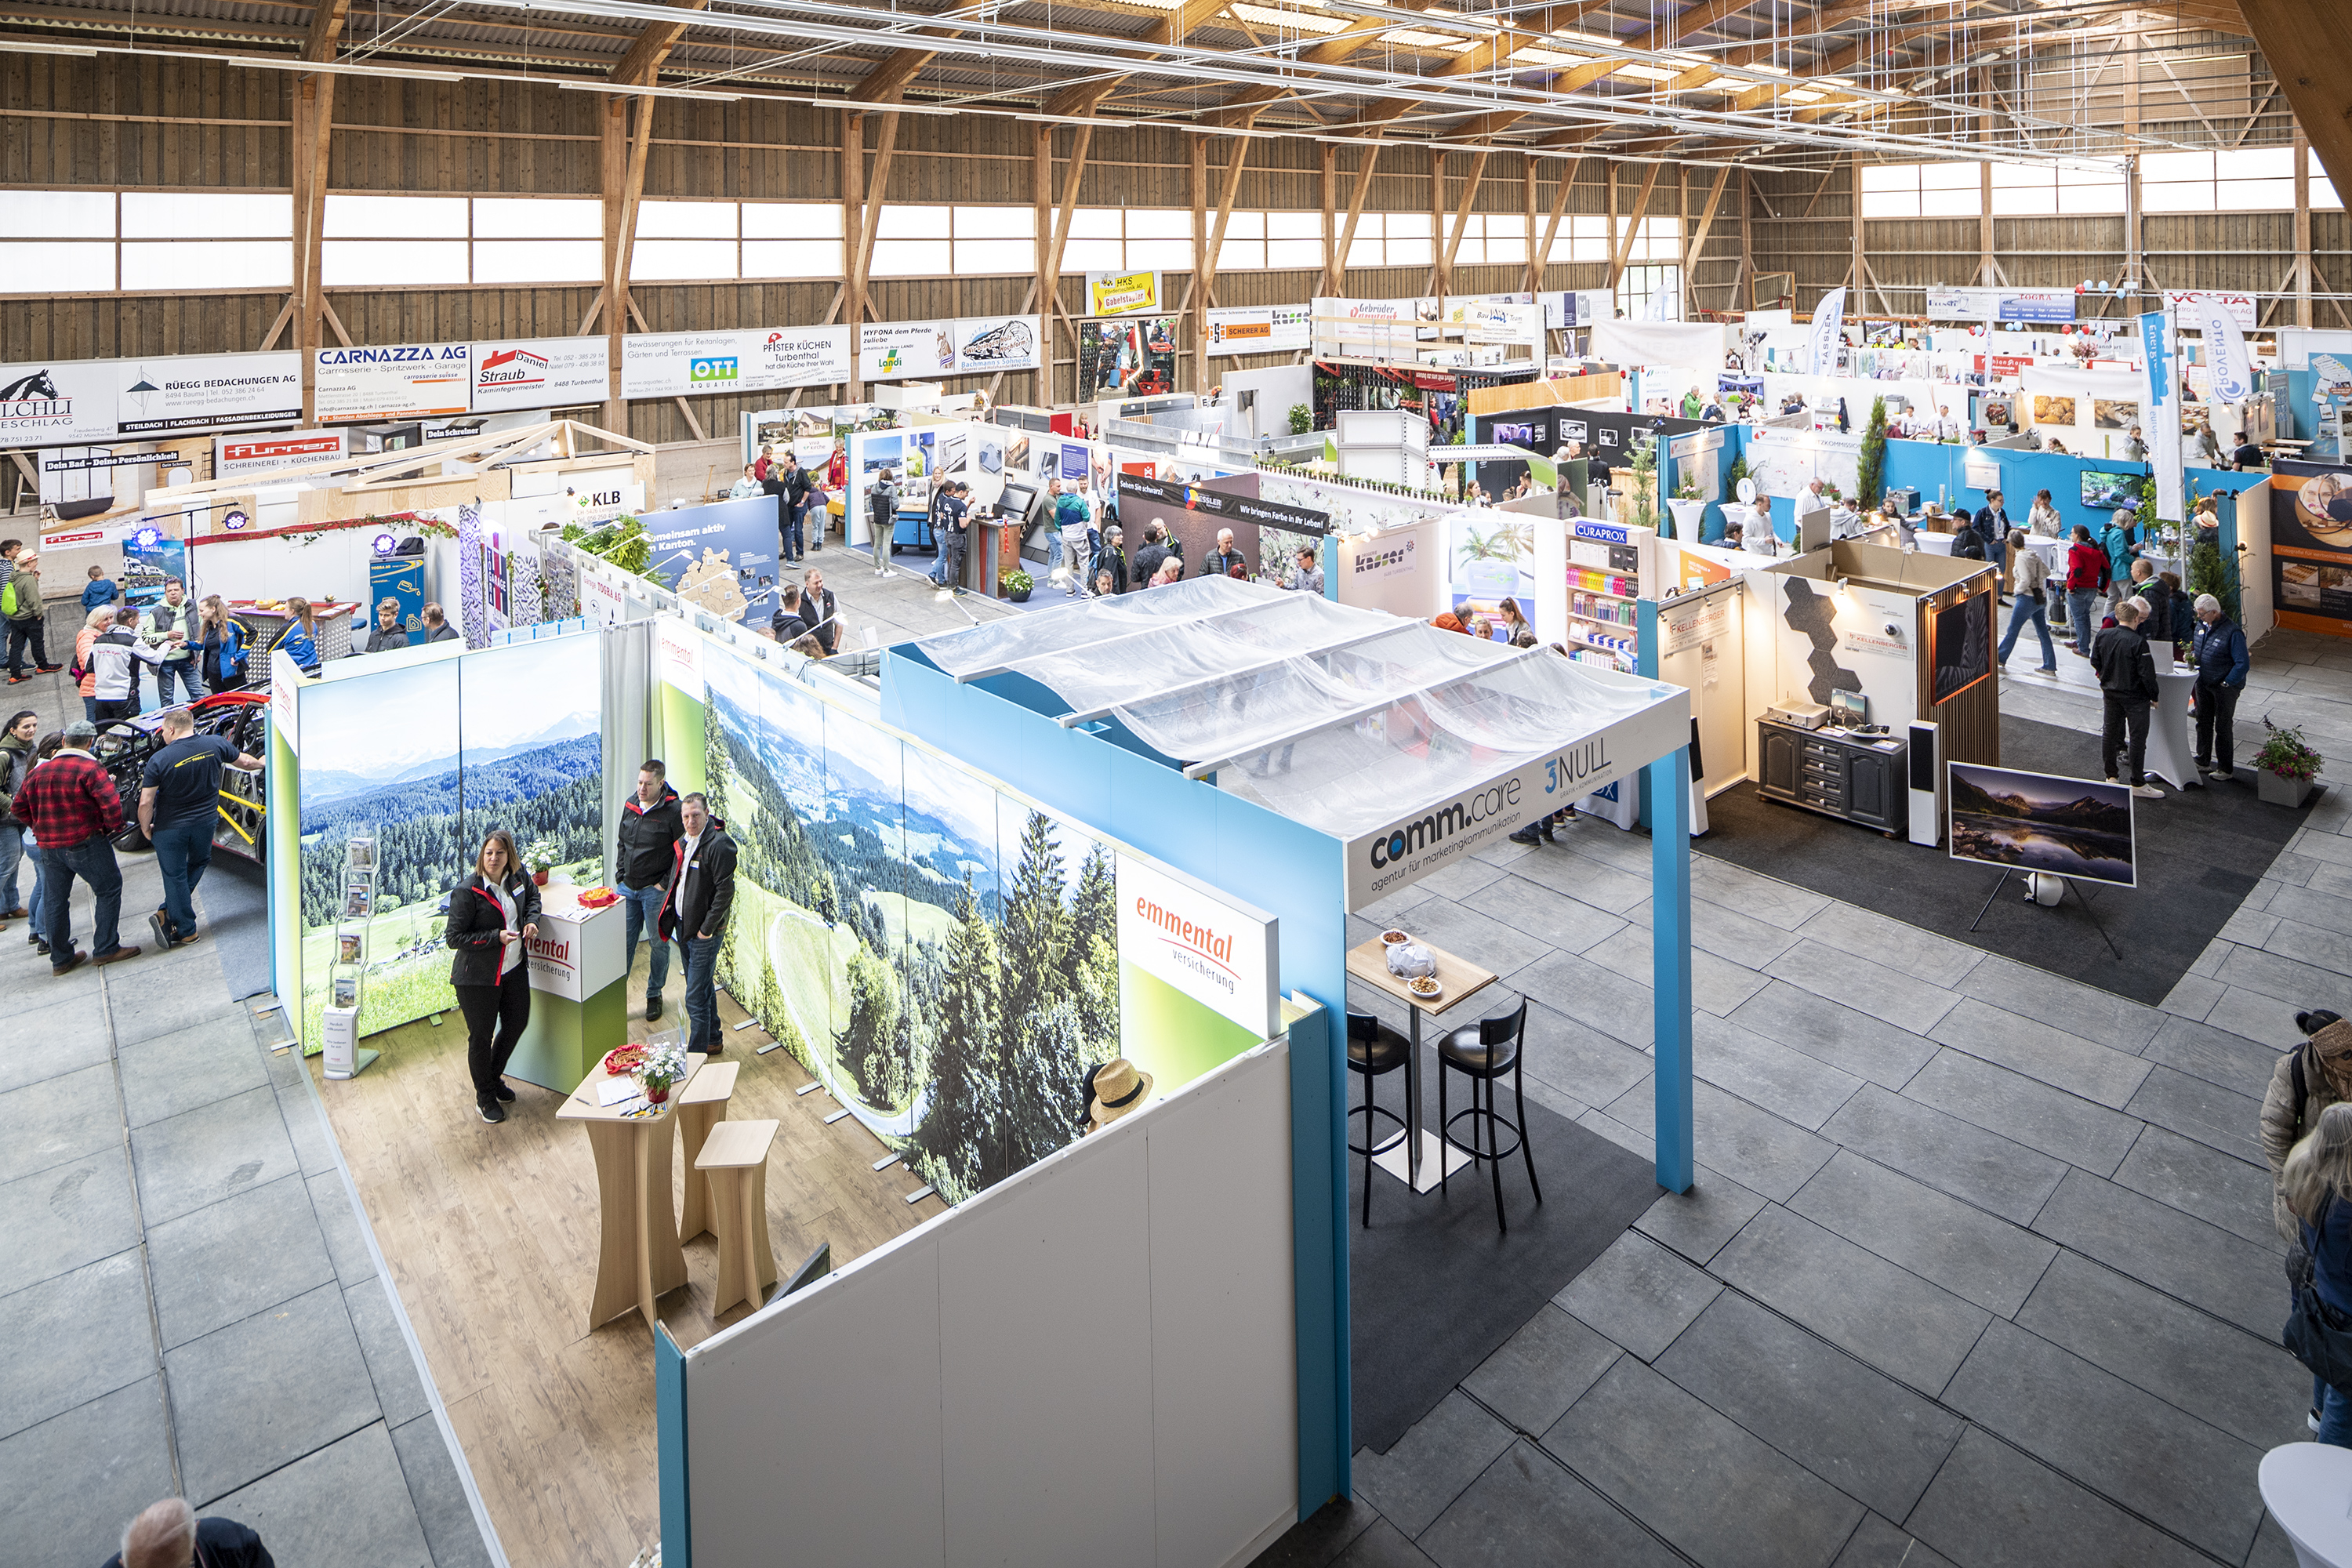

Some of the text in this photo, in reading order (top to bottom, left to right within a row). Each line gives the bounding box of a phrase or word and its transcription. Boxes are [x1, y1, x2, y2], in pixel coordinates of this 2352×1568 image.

[1116, 277, 1133, 287] HKS
[1105, 285, 1135, 295] Fördertechnik
[1105, 293, 1143, 307] Gabelstapler
[1359, 303, 1394, 313] Gebrüder
[1272, 310, 1310, 325] kasse
[627, 339, 682, 348] Bewässerungen
[696, 337, 737, 347] Reitanlagen,
[763, 340, 831, 353] PFISTER KÜCHEN
[978, 340, 1000, 351] bringen
[1000, 336, 1012, 344] Holz
[1000, 339, 1029, 353] Hochform!
[319, 346, 466, 365] CARNAZZA AG
[516, 353, 548, 369] Daniel
[627, 350, 653, 358] Gärten
[775, 351, 819, 361] Turbenthal
[318, 366, 372, 375] Carrosserie
[380, 364, 426, 372] Spritzwerk
[695, 360, 734, 377] OTT
[879, 358, 902, 368] Landi
[165, 379, 201, 390] RÜEGG
[204, 376, 279, 388] BEDACHUNGEN
[480, 368, 525, 383] Straub
[477, 383, 545, 394] Kaminfegermeister
[165, 395, 255, 407] www.rueegg-bedachungen.ch
[125, 411, 296, 430] STEILDACH FLACHDACH FASSADENBEKLEIDUNGEN
[445, 428, 479, 437] Schreiner
[47, 452, 178, 470] Dein Bad Deine Persönlichkeit
[224, 454, 340, 470] SCHREINEREI KÜCHENBAU
[1120, 481, 1134, 490] Sehen
[1142, 485, 1163, 495] schwarz?
[593, 491, 620, 506] KLB
[1240, 504, 1250, 514] Wir
[1250, 507, 1271, 519] bringen
[1272, 510, 1287, 522] Farbe
[1288, 514, 1294, 523] in
[1304, 517, 1323, 529] Leben!
[652, 523, 726, 541] emeinsam aktiv
[1577, 525, 1625, 542] CURAPROX
[659, 538, 696, 551] Kanton.
[1356, 549, 1404, 573] kasser
[2280, 547, 2304, 557] Fotografie
[2313, 552, 2336, 561] wertvolle
[597, 582, 613, 598] TOGRA
[615, 592, 622, 602] AG
[1678, 610, 1725, 633] KELLENBERGER
[1857, 637, 1907, 650] KELLENBERGER
[662, 638, 693, 665] emmental
[1544, 737, 1612, 794] 3NULL
[1559, 768, 1613, 799] GRAFIK KOMMUNIKATION
[1370, 778, 1521, 869] comm.care
[1371, 811, 1521, 891] agentur für marketingkommunikation
[1137, 897, 1232, 963] emmental
[1173, 949, 1234, 994] versicherung
